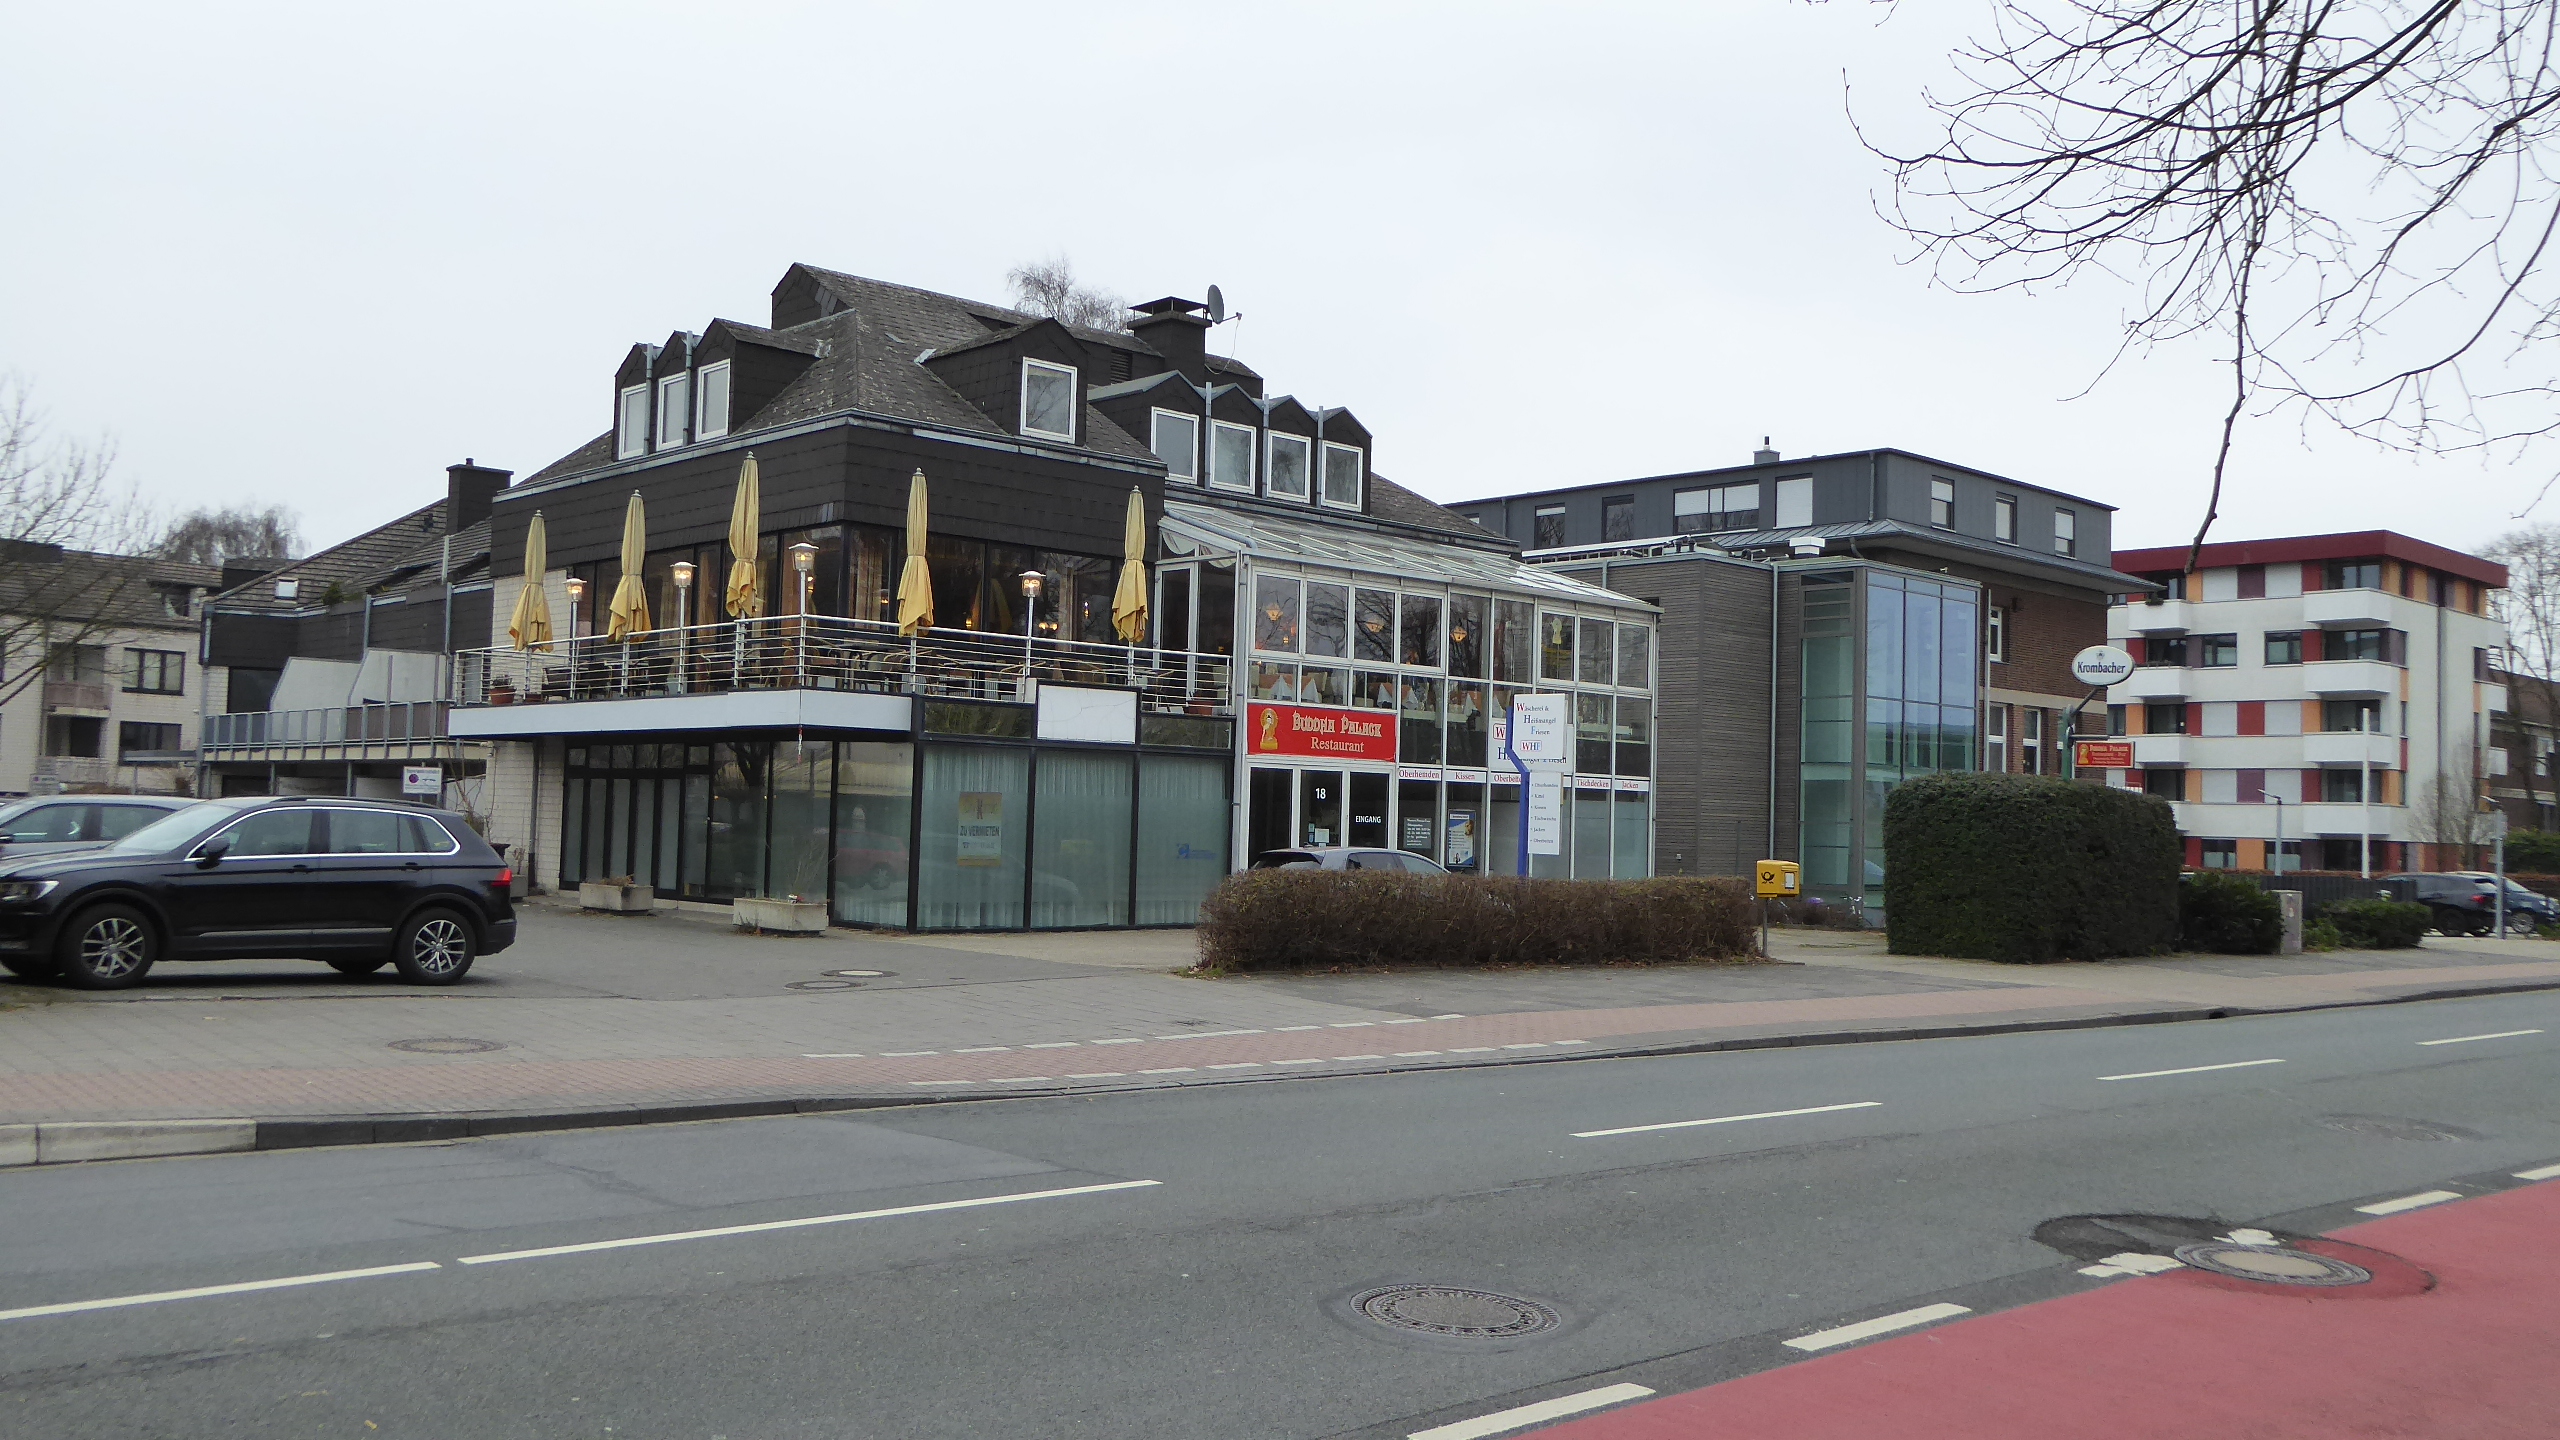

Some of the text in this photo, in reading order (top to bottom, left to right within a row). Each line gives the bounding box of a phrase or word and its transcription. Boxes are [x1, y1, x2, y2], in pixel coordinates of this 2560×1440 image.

[2077, 662, 2125, 674] Krombacher
[1516, 702, 1544, 712] Wäscherei
[1292, 710, 1383, 738] BUDDHA PALACE
[1311, 737, 1365, 753] Restaurant
[1522, 741, 1541, 752] WHF
[1399, 769, 1440, 779] Oberhemden
[1455, 771, 1476, 781] Kissen
[1576, 779, 1610, 788] Tischdecken
[1621, 781, 1639, 789] Jacken
[1315, 787, 1326, 799] 18
[1355, 815, 1381, 823] EINGANG
[960, 825, 1000, 836] ZU VERMIETEN
